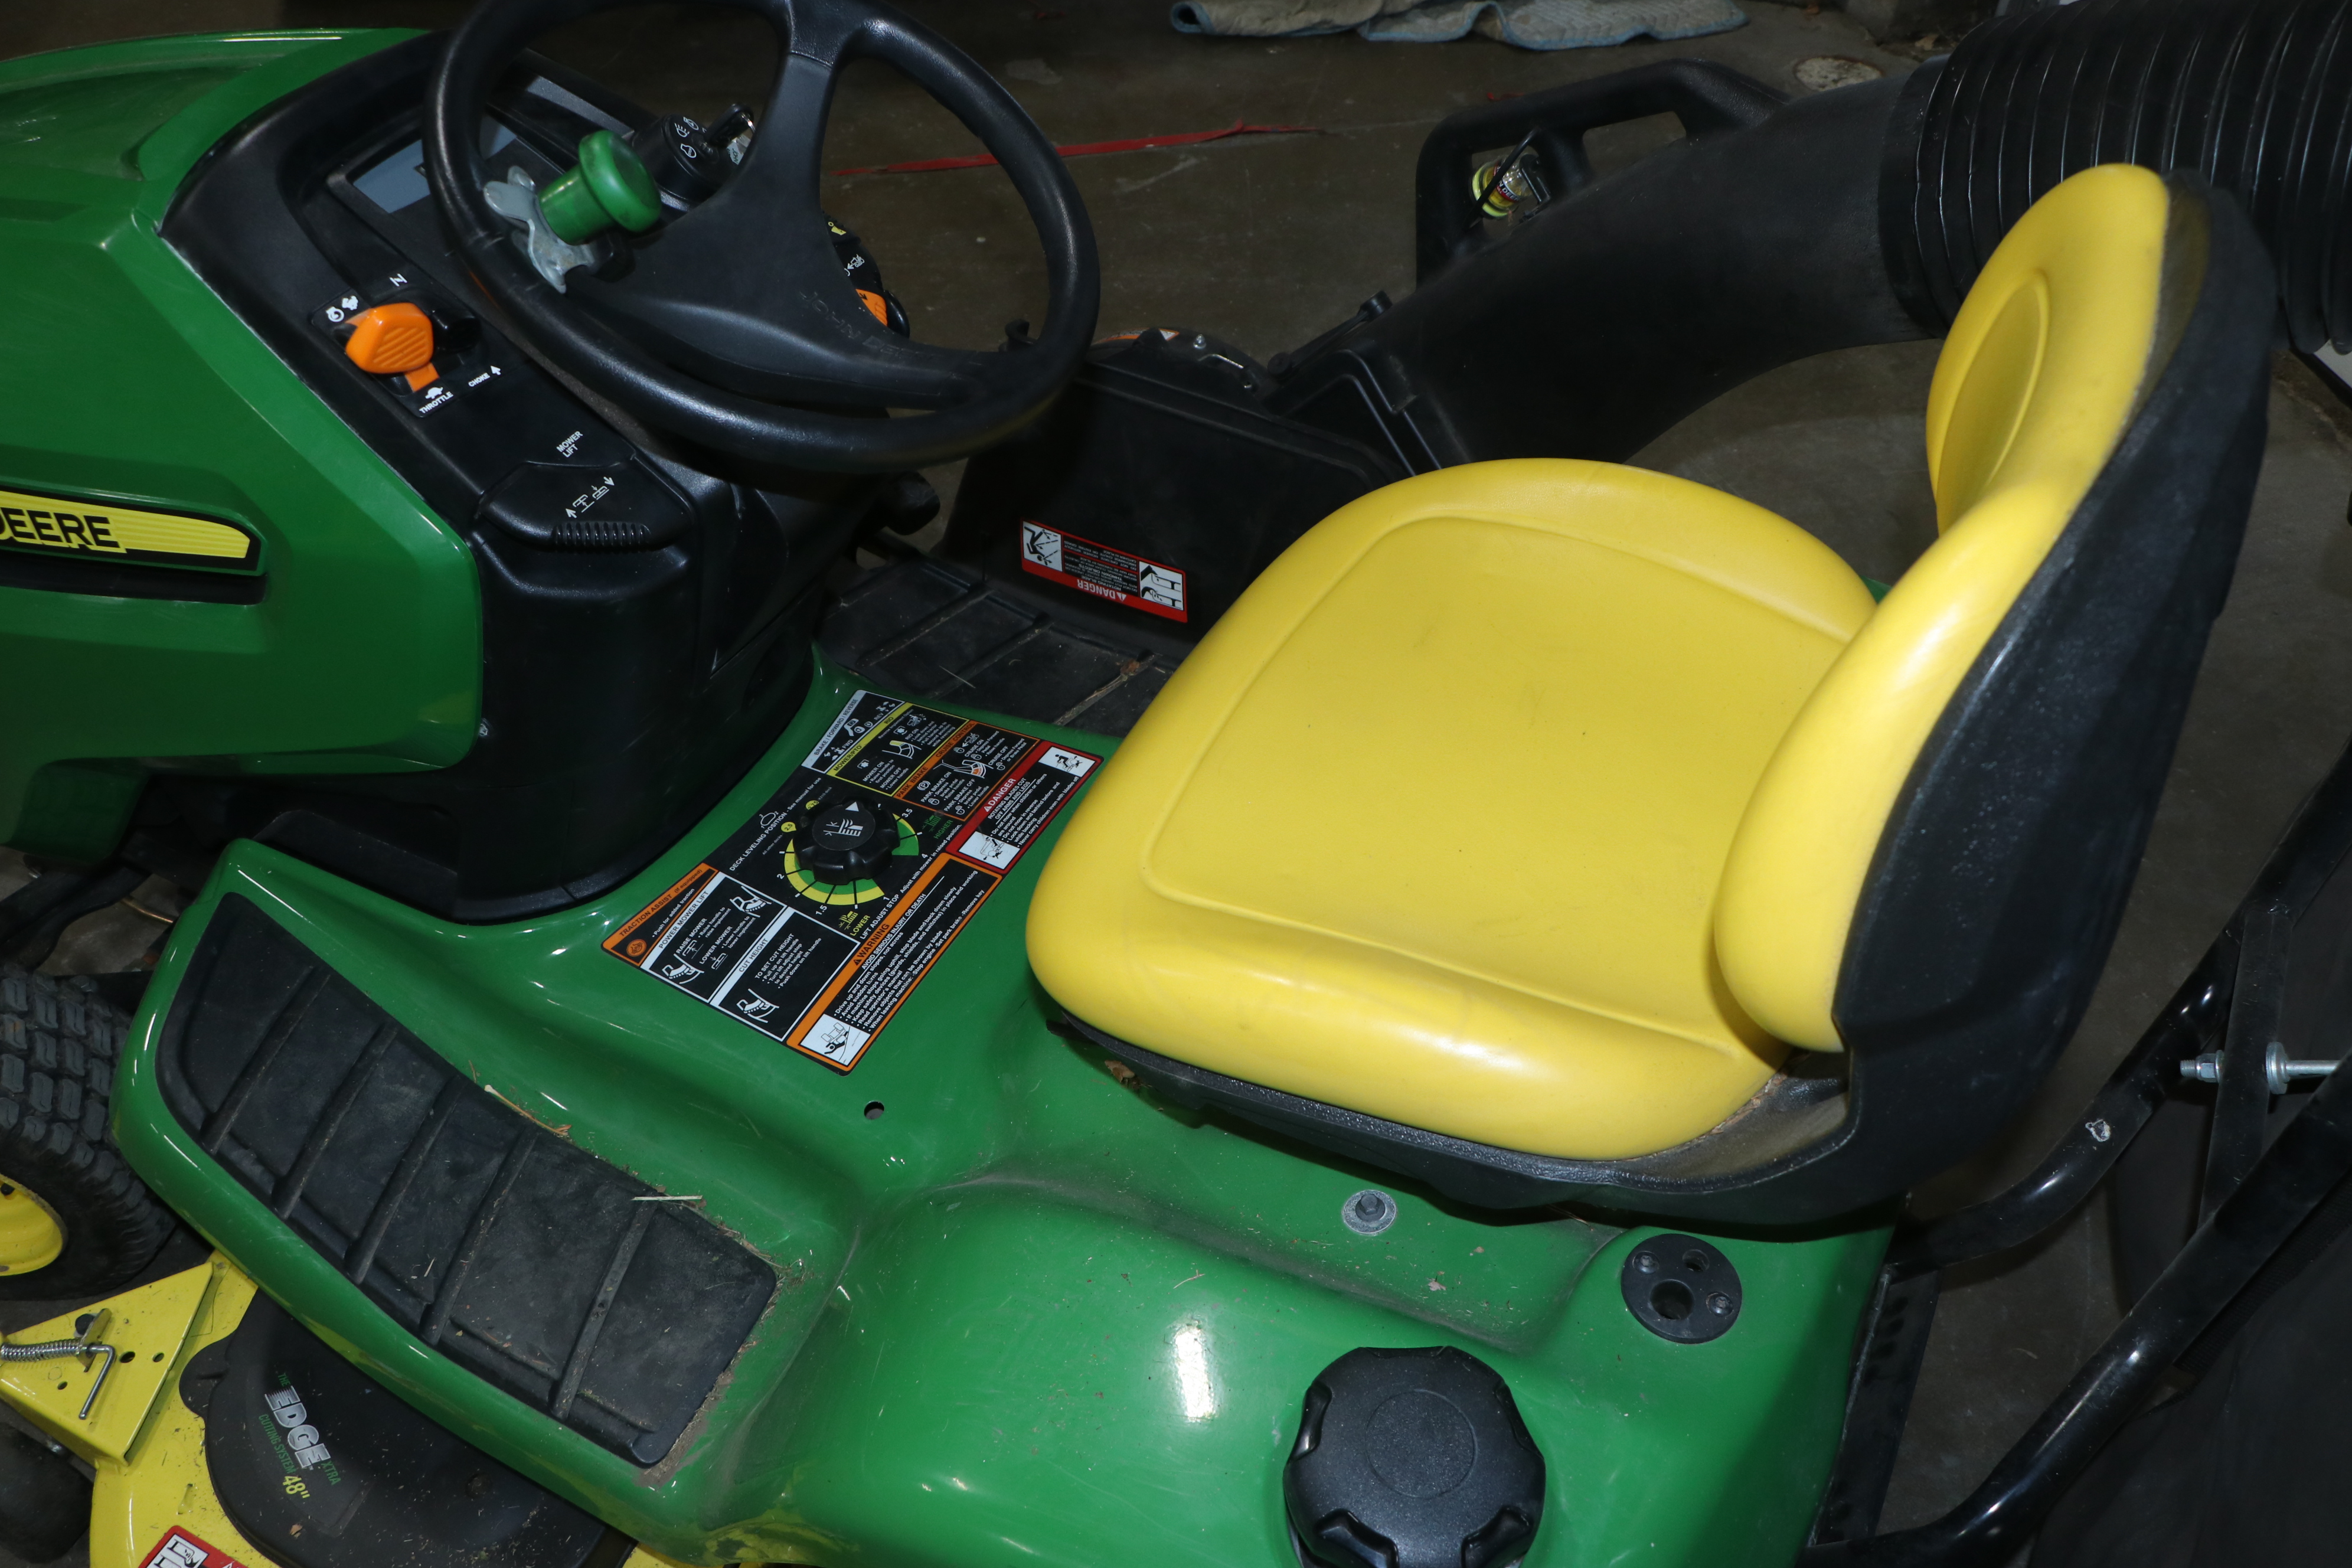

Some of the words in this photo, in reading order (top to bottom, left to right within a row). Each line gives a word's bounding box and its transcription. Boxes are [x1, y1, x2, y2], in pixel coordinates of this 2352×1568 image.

[468, 373, 491, 387] CHOKE
[419, 391, 454, 414] THROTTLE
[556, 431, 583, 453] MOWER
[562, 444, 578, 458] LIFT
[0, 507, 120, 549] EERE
[1079, 563, 1100, 574] OBJECTS
[1081, 575, 1097, 583] BLADE
[1101, 571, 1122, 581] THROWN
[1077, 579, 1116, 600] DANGER
[1097, 580, 1122, 591] ROTATING
[814, 740, 828, 755] BRAKE
[827, 717, 844, 738] FORWARD
[842, 698, 858, 716] REVERSE
[873, 712, 884, 720] REV
[841, 739, 854, 749] FWD
[935, 741, 954, 757] CRUISE
[952, 723, 975, 741] CONTROL
[964, 744, 979, 757] CRUISE
[833, 745, 862, 772] MOWER/PTO
[988, 752, 1002, 766] CRUISE
[999, 745, 1008, 753] OFF
[863, 767, 879, 782] MOWER
[880, 774, 896, 789] MOWER
[893, 767, 901, 775] OFF
[896, 783, 912, 798] PARK
[910, 766, 929, 783] BRAKE
[920, 790, 933, 802] PARK
[930, 778, 946, 792] BRAKE
[943, 799, 956, 812] PARK
[953, 786, 969, 801] BRAKE
[966, 778, 975, 787] OFF
[987, 800, 1007, 819] ROTATING
[1004, 785, 1020, 801] BLADES
[1017, 777, 1027, 786] CUT
[988, 778, 1017, 806] DANGER
[995, 811, 1004, 819] OFF
[1002, 799, 1014, 812] ARMS
[1012, 791, 1021, 801] AND
[1018, 781, 1031, 792] LEGS
[901, 808, 913, 818] 3.5
[729, 856, 745, 871] DECK
[742, 834, 767, 857] LEVELING
[764, 812, 788, 834] POSITION
[795, 789, 809, 803] manual
[933, 819, 953, 839] HIGHER
[860, 927, 871, 940] LIFT
[870, 907, 888, 929] ADJUST
[886, 894, 899, 908] STOP
[900, 879, 914, 894] Adjust
[912, 871, 921, 880] with
[919, 856, 933, 871] mower
[935, 839, 948, 852] raised
[946, 824, 962, 841] position.
[619, 910, 651, 936] TRACTION
[651, 894, 672, 913] ASSIST
[680, 869, 703, 888] equipped)
[653, 923, 665, 935] Push
[669, 903, 681, 917] added
[680, 888, 695, 904] traction
[815, 904, 828, 915] 1.5
[658, 926, 680, 949] POWER
[677, 903, 698, 926] MOWER
[696, 890, 708, 903] LIFT
[699, 924, 711, 936] Raise
[708, 912, 721, 925] handle
[705, 927, 715, 938] raise
[713, 908, 731, 928] implement
[723, 933, 735, 946] Lower
[733, 920, 746, 934] handle
[727, 937, 739, 949] lower
[737, 917, 756, 937] implement
[850, 914, 871, 936] LOWER
[861, 954, 876, 970] AVOID
[873, 933, 893, 955] SERIOUS
[890, 916, 906, 934] INJURY
[904, 909, 914, 917] OR
[910, 893, 926, 909] DEATH
[675, 937, 691, 954] RAISE
[688, 918, 707, 937] MOWER
[699, 945, 717, 965] LOWER
[714, 926, 733, 945] MOWER
[850, 994, 868, 1015] machine
[866, 981, 879, 995] stops
[877, 967, 891, 982] going
[888, 954, 901, 968] uphill,
[899, 943, 910, 954] stop
[907, 930, 920, 943] blade
[918, 922, 927, 931] and
[924, 912, 936, 923] back
[933, 900, 945, 912] down
[943, 886, 957, 900] slowly
[857, 923, 890, 958] WARNING
[739, 959, 750, 972] CUT
[749, 938, 768, 960] HEIGHT
[761, 961, 771, 972] SET
[769, 950, 779, 962] CUT
[778, 933, 794, 952] HEIGHT
[835, 1001, 848, 1014] Drive
[851, 984, 861, 994] and
[859, 971, 871, 984] down
[870, 955, 886, 971] slopes,
[883, 946, 891, 955] not
[889, 932, 904, 948] across
[863, 1007, 881, 1027] Remove
[880, 989, 896, 1007] objects
[893, 979, 903, 989] that
[901, 971, 910, 981] can
[913, 949, 928, 965] thrown
[930, 930, 943, 943] blade
[841, 1001, 854, 1017] Avoid
[852, 985, 868, 1002] sudden
[865, 972, 878, 985] turns
[858, 1010, 871, 1024] Read
[868, 987, 889, 1011] operator's
[887, 970, 903, 988] manual
[277, 1372, 292, 1387] THE
[265, 1385, 331, 1469] EDGE
[259, 1413, 282, 1445] CUTTING
[274, 1443, 297, 1474] SYSTEM
[282, 1475, 311, 1498] 48"
[321, 1460, 342, 1486] XTRA
